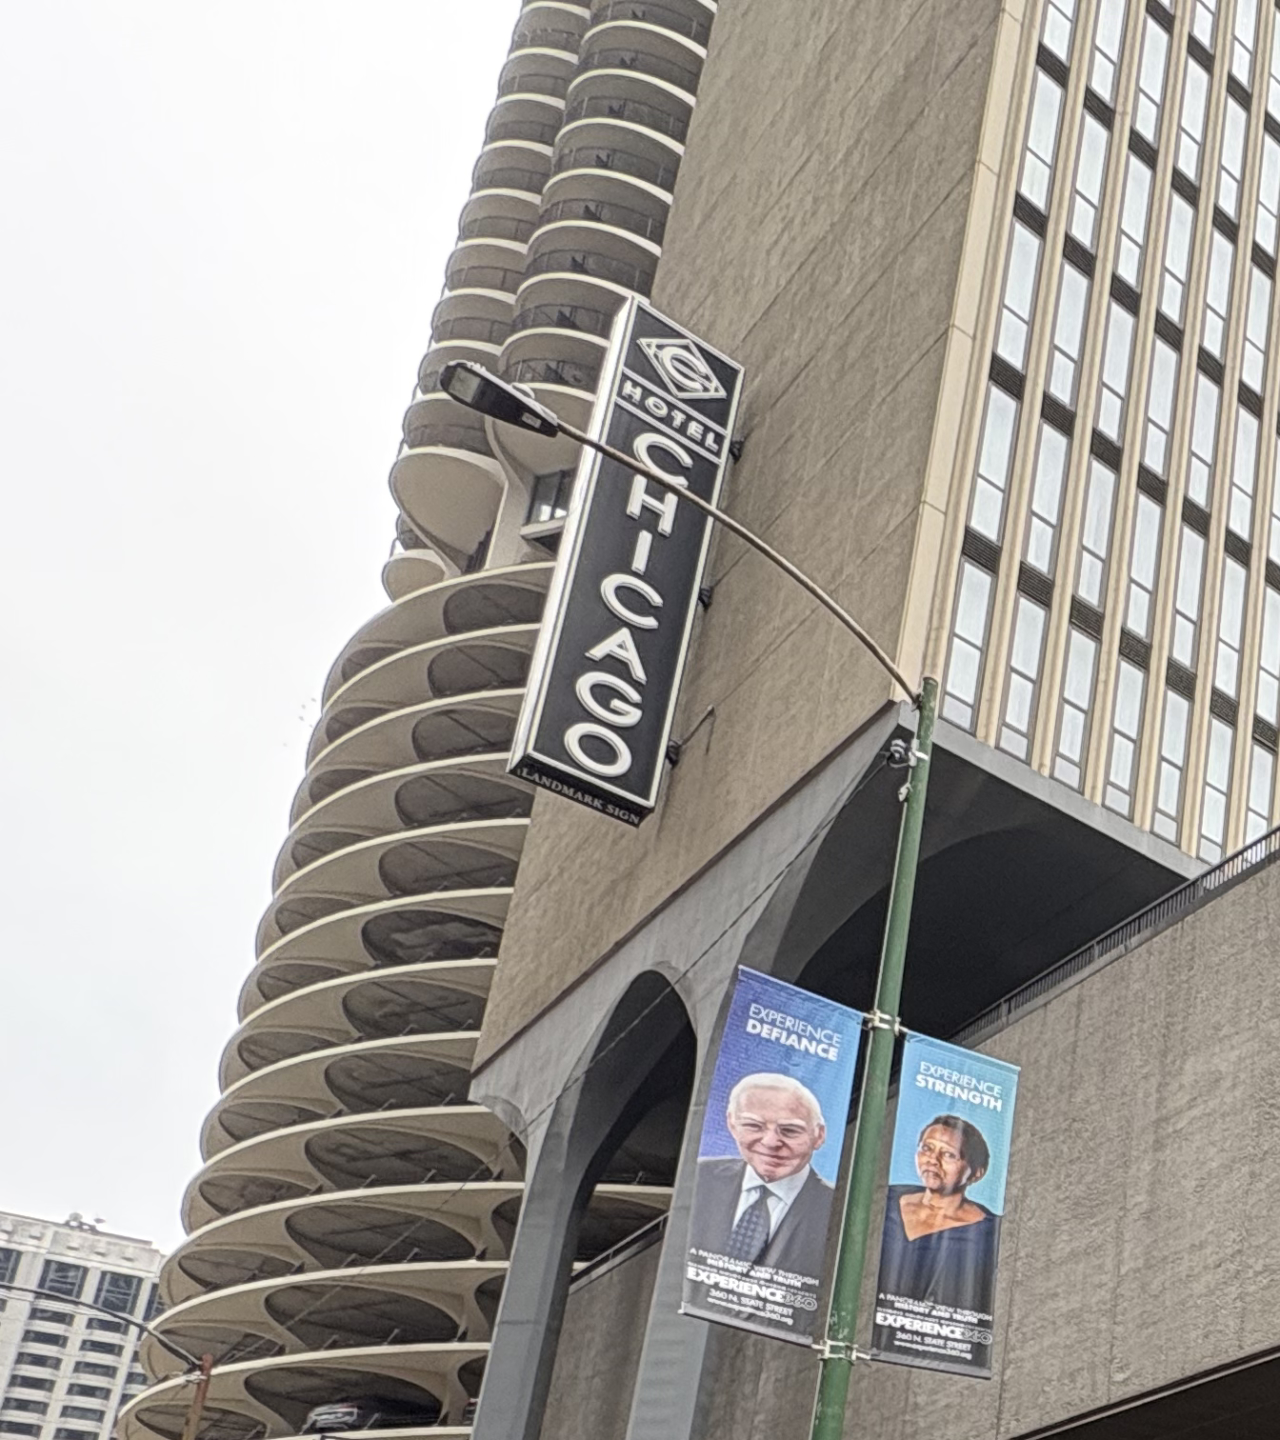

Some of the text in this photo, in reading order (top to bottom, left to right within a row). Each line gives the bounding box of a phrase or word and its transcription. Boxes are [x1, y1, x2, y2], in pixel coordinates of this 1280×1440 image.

[621, 379, 719, 453] HOTEL
[564, 432, 694, 778] CHICAGO
[521, 768, 641, 825] LANDMARK SIGN
[746, 1018, 839, 1062] DEFIANCE
[749, 1002, 843, 1048] EXPERIENCE
[915, 1074, 1003, 1112] STRENGTH
[919, 1061, 1003, 1098] EXPERIENCE
[689, 1247, 697, 1256] A
[709, 1288, 728, 1300] 360
[741, 1296, 764, 1310] STATE
[765, 1302, 794, 1317] STREET
[895, 1331, 912, 1340] 360
